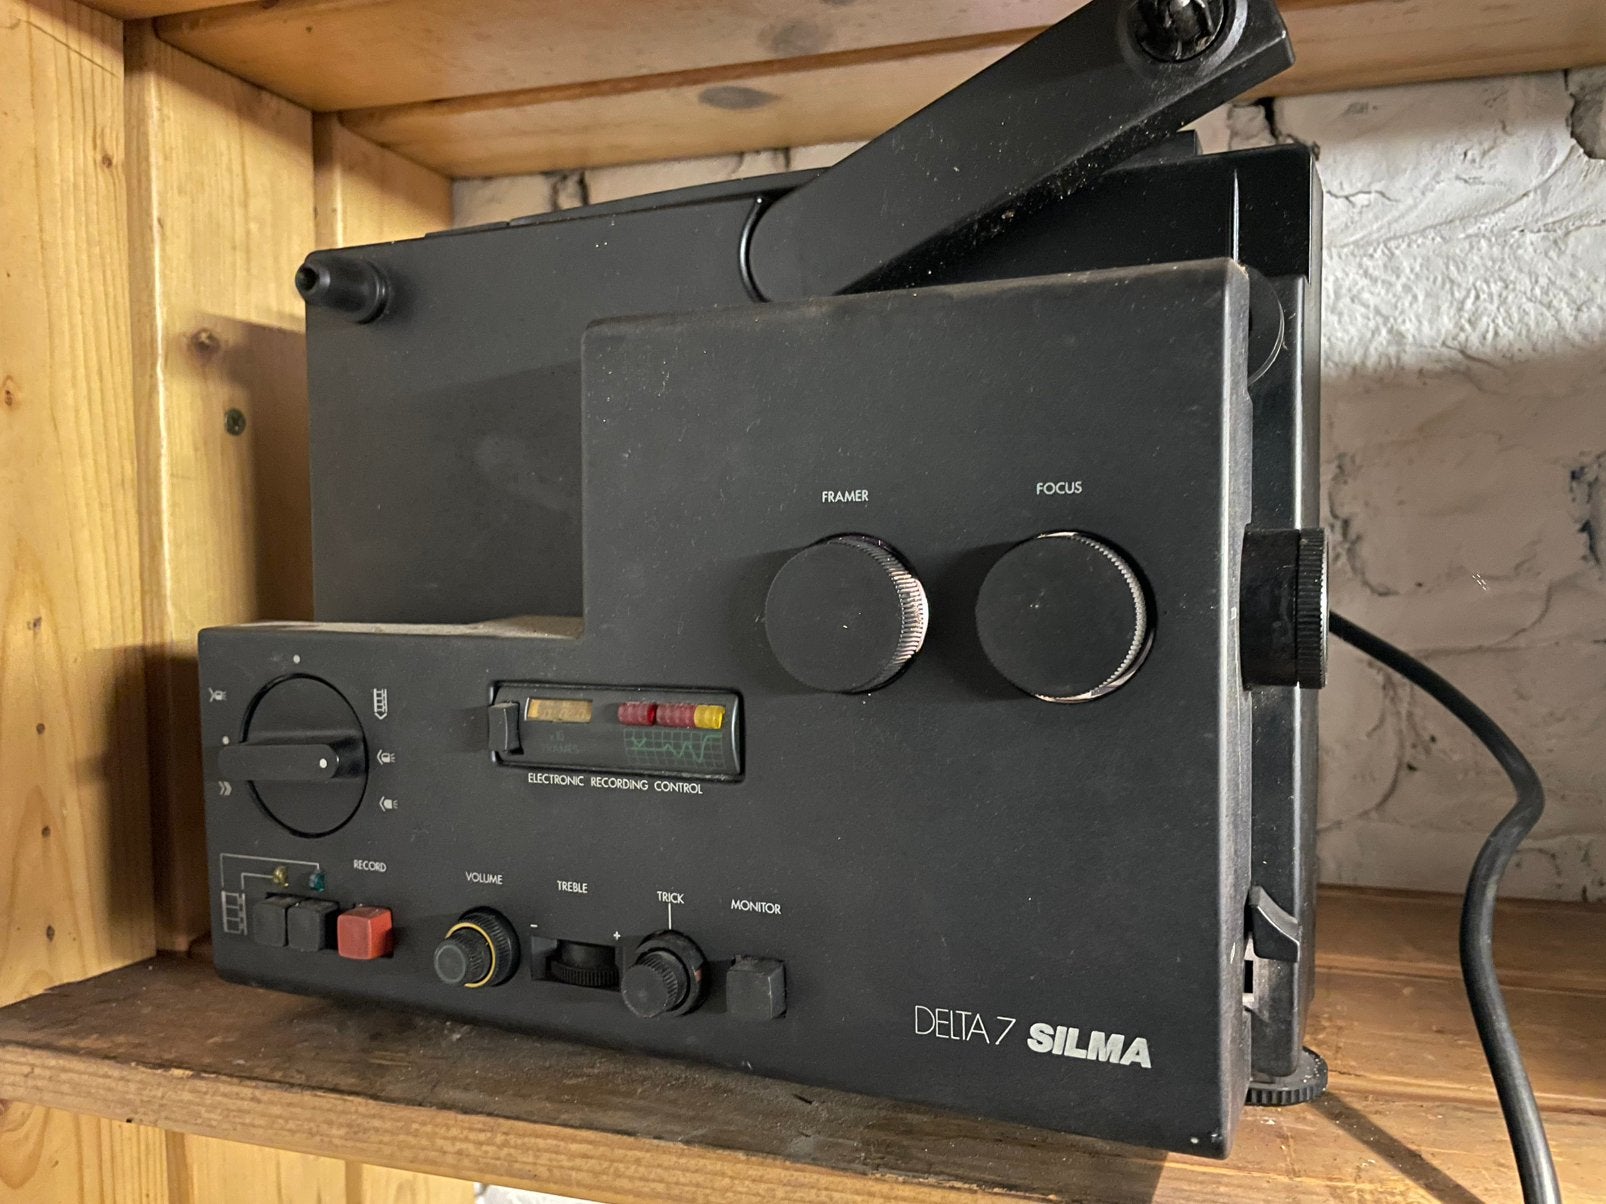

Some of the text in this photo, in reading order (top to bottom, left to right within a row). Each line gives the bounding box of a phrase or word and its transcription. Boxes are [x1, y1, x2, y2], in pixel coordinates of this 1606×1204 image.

[1036, 481, 1082, 495] FOCUS
[822, 490, 868, 502] FRAMER
[528, 773, 703, 794] ELECTRONIC RECORDING CONTROL
[353, 860, 387, 872] RECORD
[466, 872, 503, 885] VOLUME
[557, 881, 588, 893] TREBLE
[657, 891, 684, 904] TRICK
[731, 900, 781, 914] MONITOR
[915, 1005, 1152, 1068] DELTA 7 SILMA
